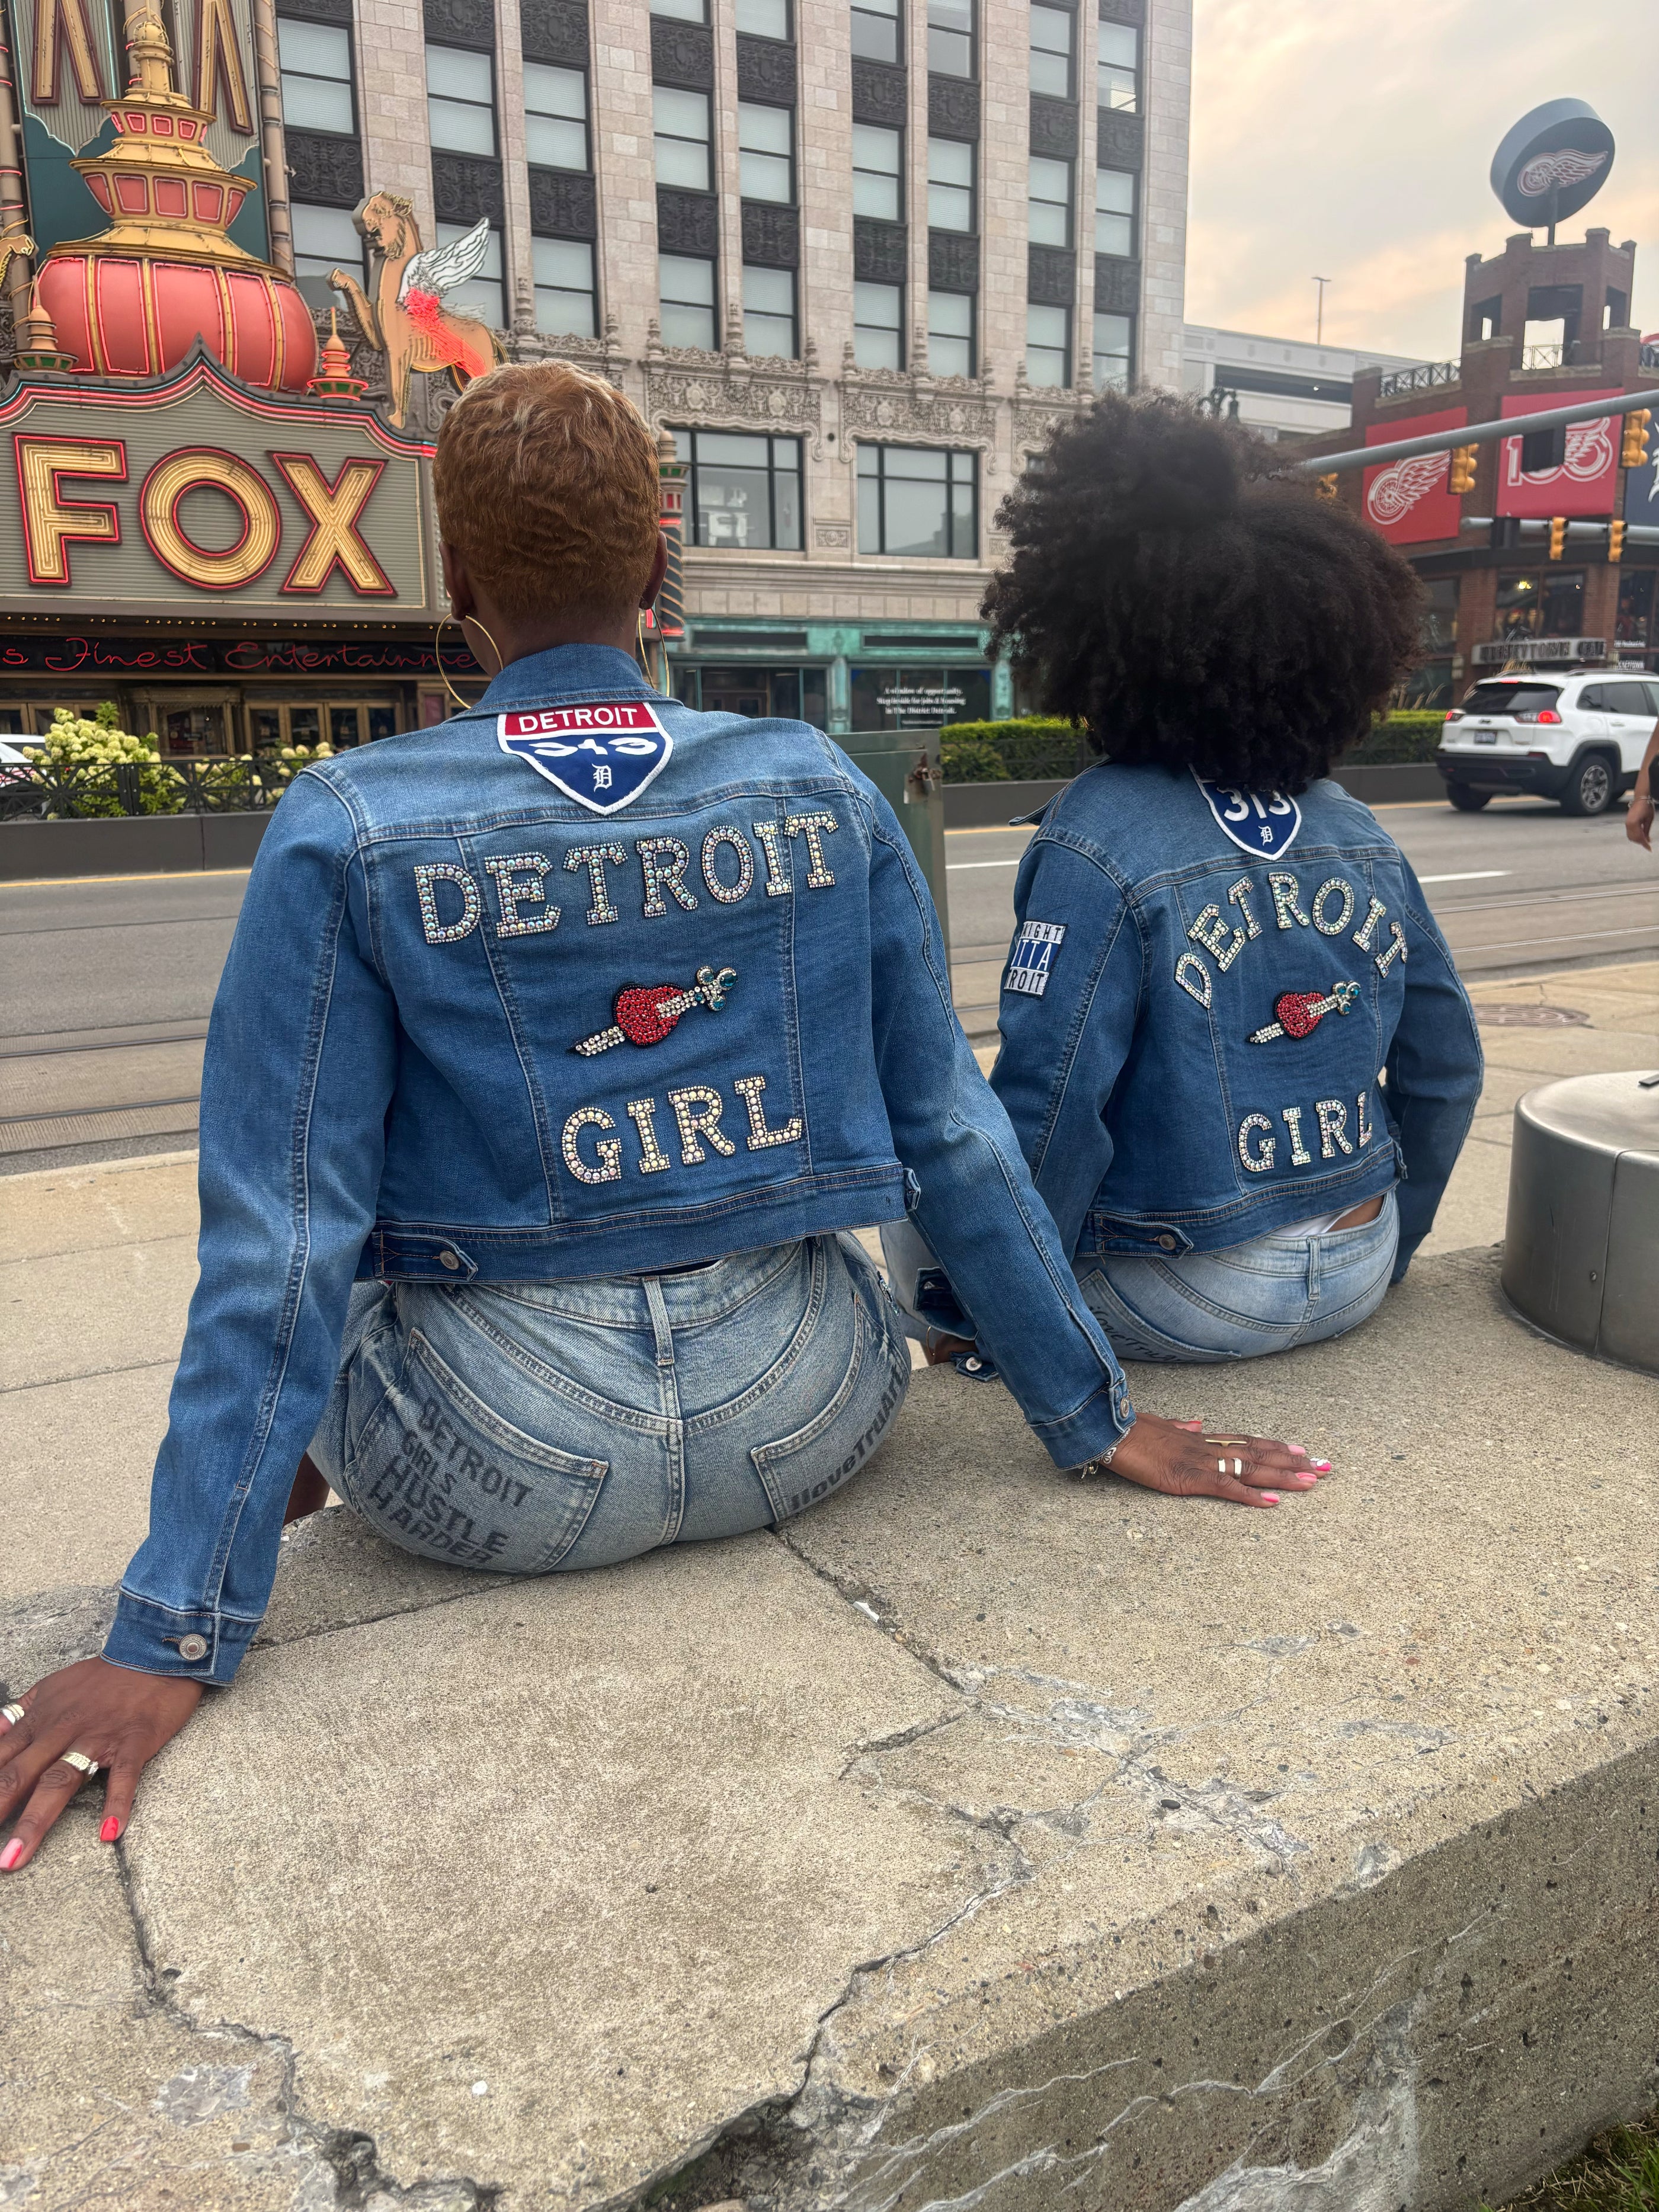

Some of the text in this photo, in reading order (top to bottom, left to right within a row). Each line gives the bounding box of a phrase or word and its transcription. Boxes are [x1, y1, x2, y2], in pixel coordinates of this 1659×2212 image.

[12, 432, 398, 597] FOX
[44, 637, 208, 671] Finest
[518, 707, 638, 732] DETROIT
[592, 763, 613, 792] D
[413, 811, 839, 945] DETROIT
[1258, 825, 1273, 846] D
[1174, 872, 1408, 1009] DETROIT
[561, 1075, 804, 1185] GIRL
[1239, 1091, 1372, 1172] GIRL
[402, 1429, 457, 1495] GIRLS
[419, 1397, 532, 1507] DETROIT
[379, 1454, 509, 1554] HUSTLE
